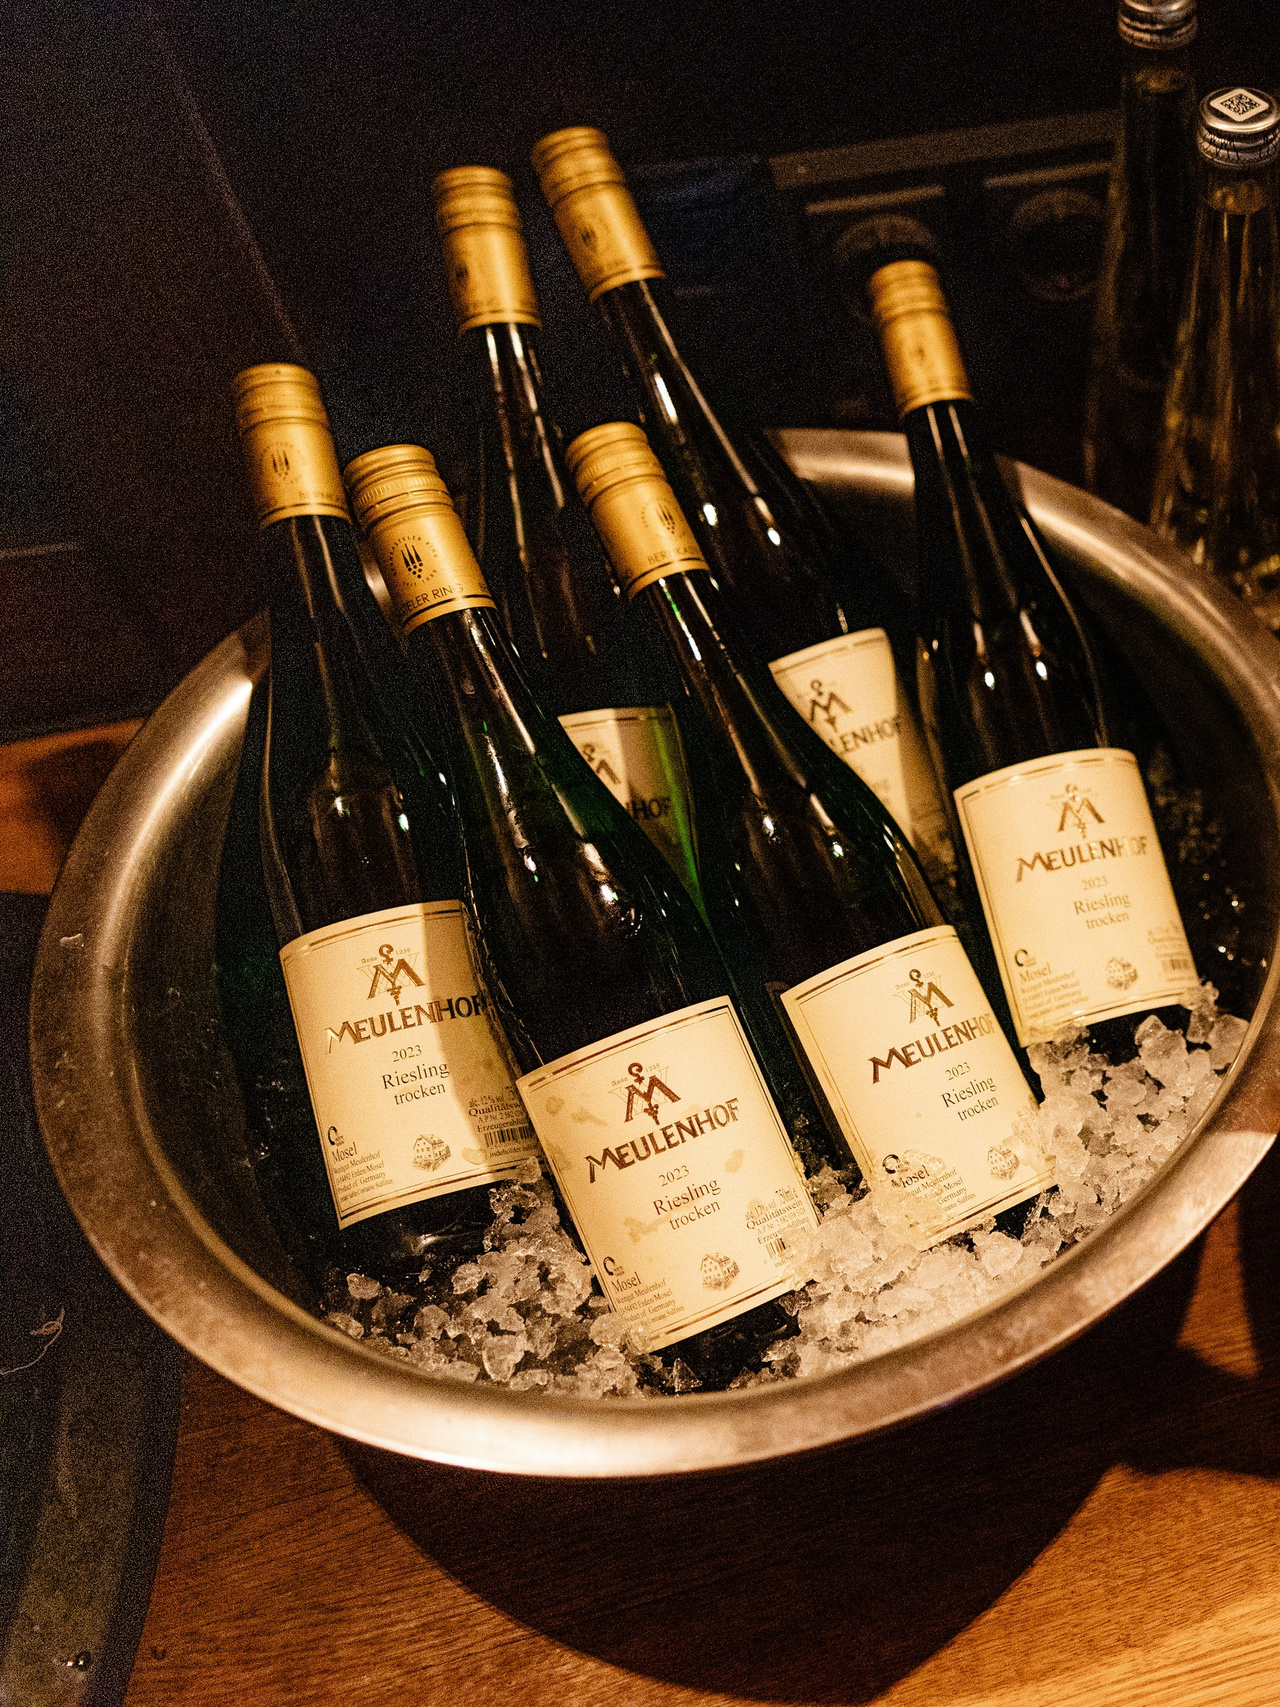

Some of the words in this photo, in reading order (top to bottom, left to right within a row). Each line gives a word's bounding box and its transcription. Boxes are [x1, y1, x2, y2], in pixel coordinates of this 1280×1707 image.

[1016, 836, 1147, 882] MEULENHOF
[1081, 876, 1109, 891] 2023
[1073, 893, 1132, 915] Riesling
[1085, 912, 1130, 929] trocken
[1019, 962, 1052, 982] Mosel
[325, 994, 484, 1054] MEULENHOF
[391, 1044, 422, 1063] 2023
[868, 1013, 995, 1085] MEULENHOF
[382, 1062, 450, 1090] Riesling
[945, 1061, 971, 1081] 2023
[394, 1083, 446, 1105] trocken
[941, 1077, 997, 1108] Riesling
[468, 1102, 522, 1117] Qualitätsw
[957, 1096, 999, 1121] trocken
[585, 1097, 739, 1183] MEULENHOF
[331, 1141, 358, 1163] Mosel
[359, 1171, 386, 1185] Germany
[658, 1165, 690, 1186] 2023
[653, 1179, 721, 1216] Riesling
[669, 1200, 721, 1230] trocken
[746, 1200, 803, 1230] Qualitätswein
[611, 1271, 642, 1294] Mosel
[634, 1278, 667, 1297] Meulenhof
[648, 1299, 676, 1314] Germany
